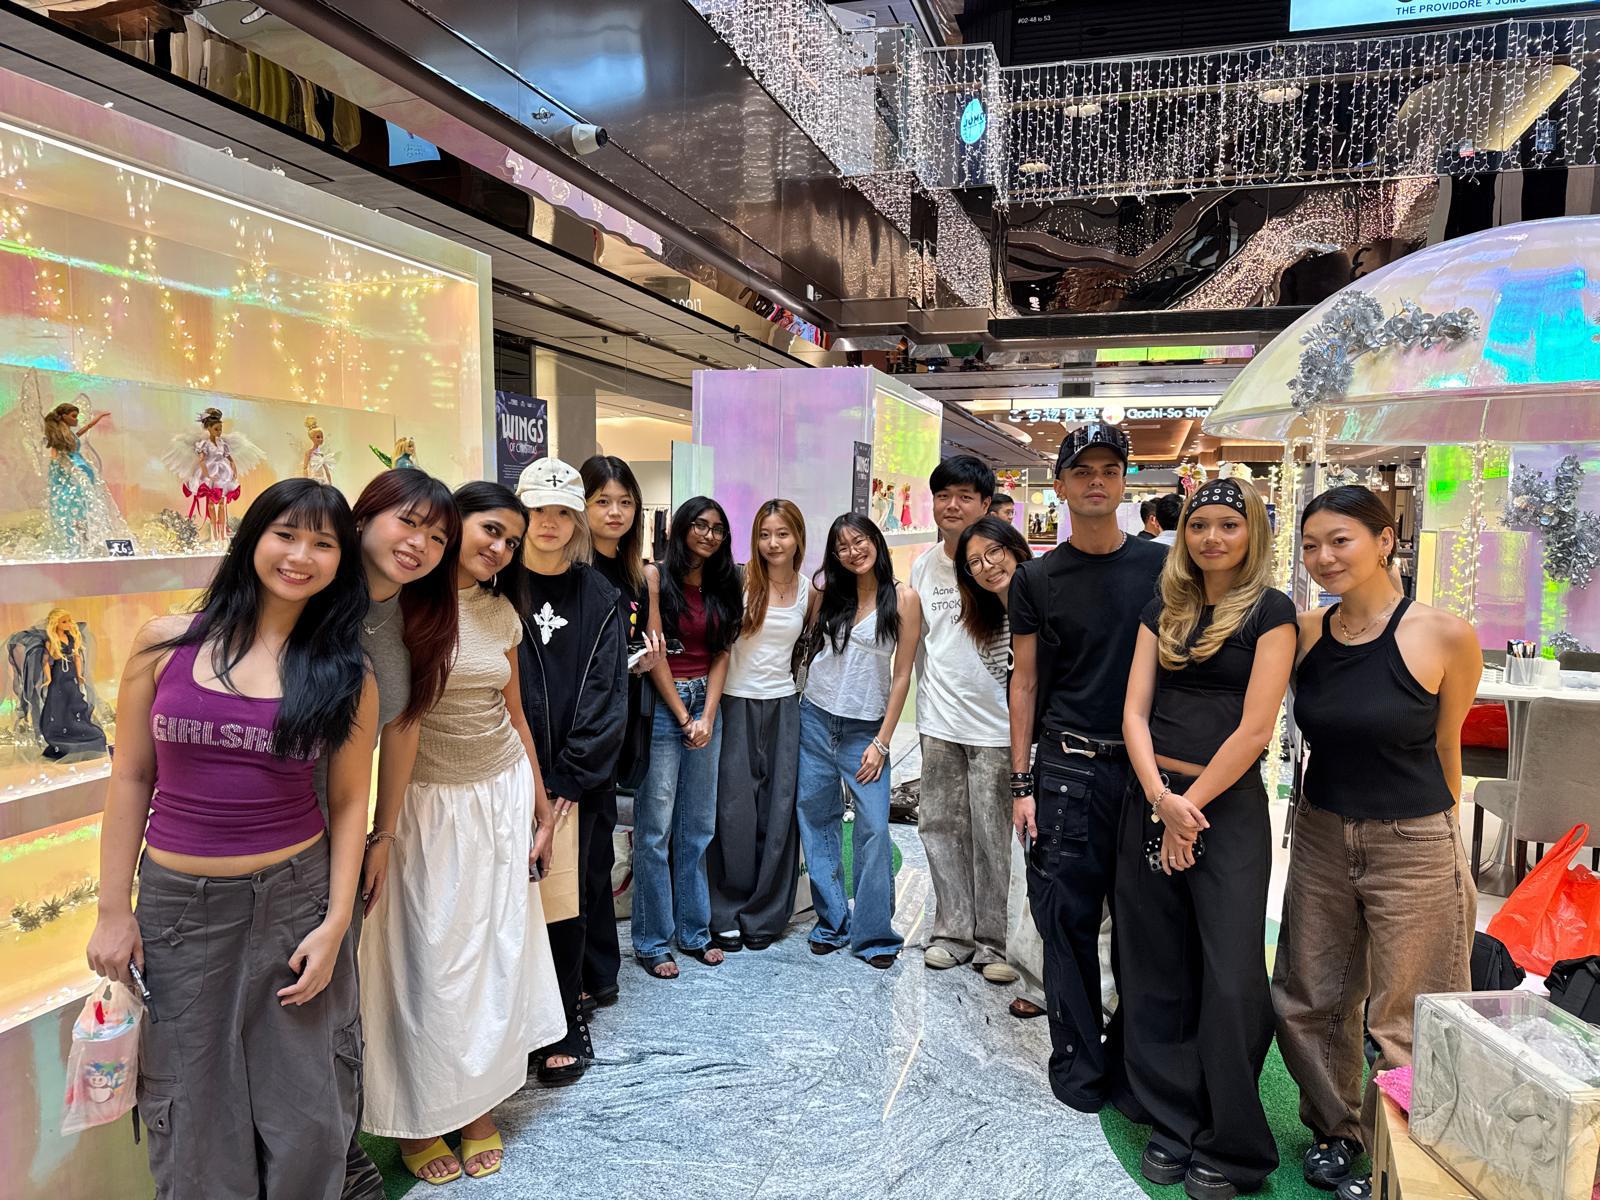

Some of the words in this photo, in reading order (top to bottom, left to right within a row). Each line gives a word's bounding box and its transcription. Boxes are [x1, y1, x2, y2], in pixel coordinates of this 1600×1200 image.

[1396, 6, 1416, 15] THE
[1419, 0, 1482, 13] PROVIDORE
[1127, 408, 1183, 419] Gochi-So
[1185, 406, 1212, 418] Sho
[502, 413, 544, 444] WINGS
[933, 586, 954, 596] Acne
